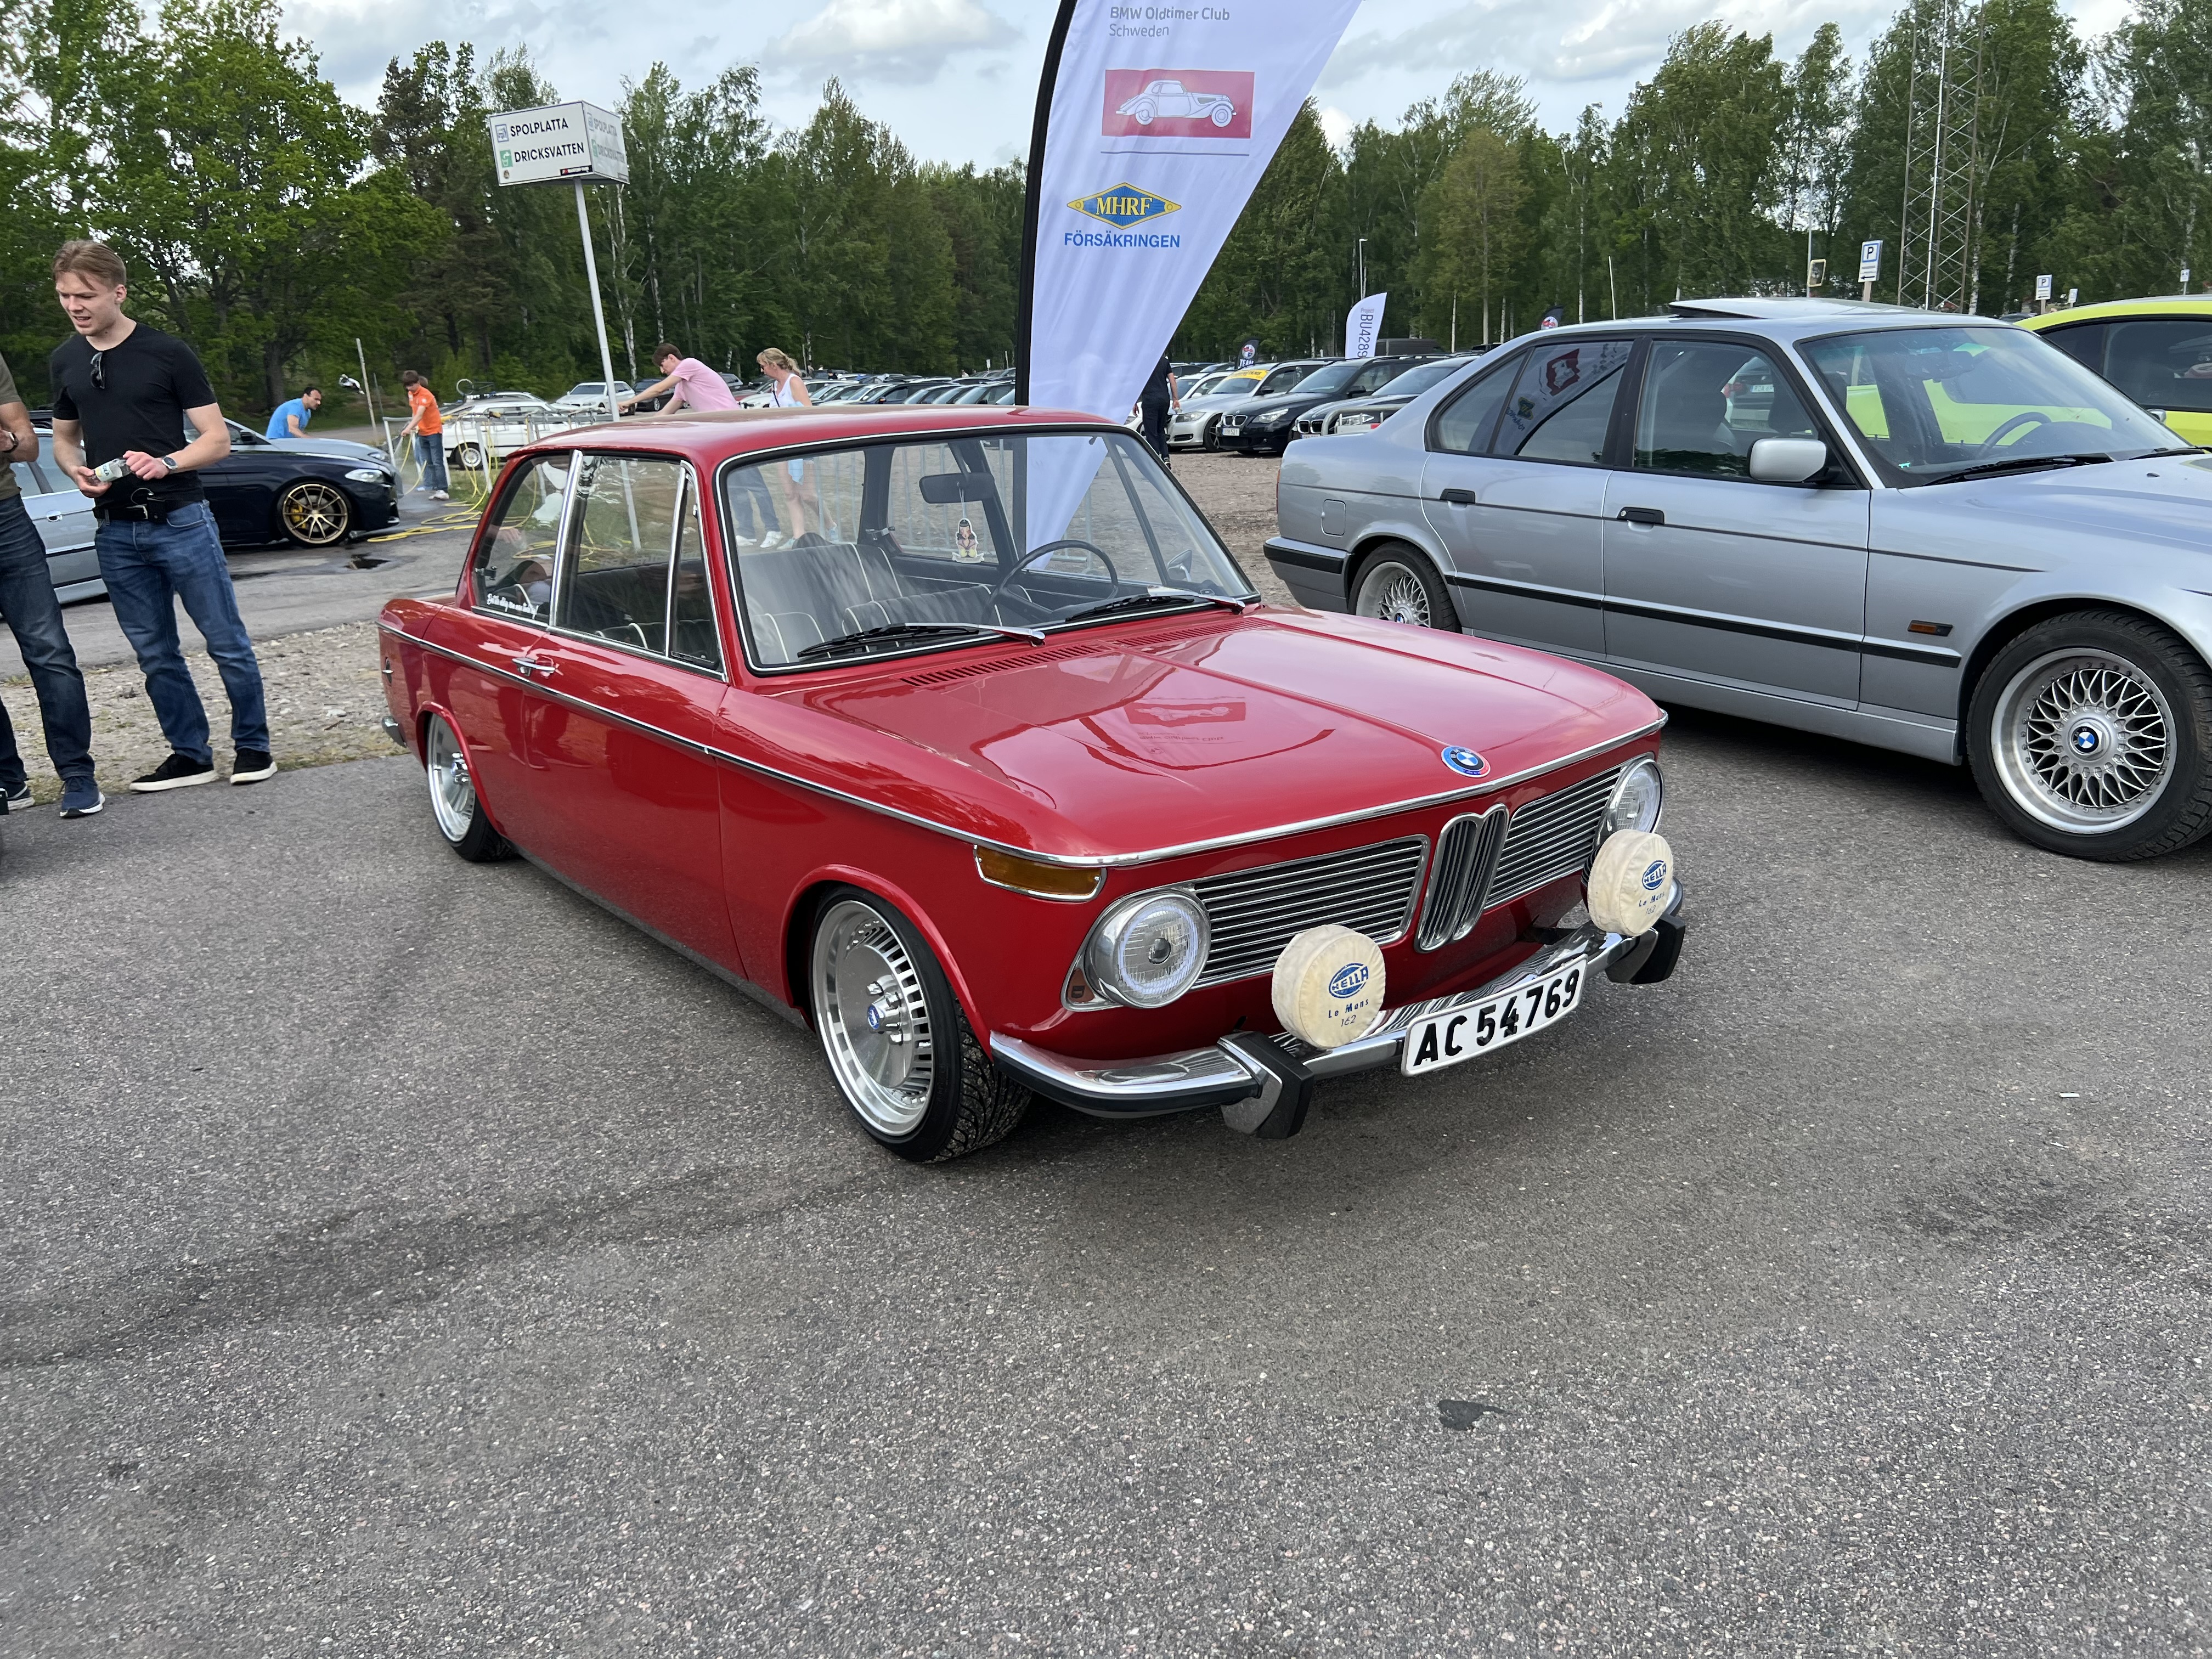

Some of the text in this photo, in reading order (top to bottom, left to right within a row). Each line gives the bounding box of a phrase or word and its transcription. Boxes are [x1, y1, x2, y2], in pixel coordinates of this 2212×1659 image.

[1110, 7, 1230, 20] BMW Oldtimer Club
[1109, 24, 1169, 37] Schweden
[510, 117, 568, 137] SPOLPLATTA
[514, 142, 584, 162] DRICKSVATTEN
[1096, 196, 1153, 216] MHRF
[1064, 230, 1180, 247] FÖRSÄKRINGEN
[1866, 246, 1874, 259] P
[1450, 749, 1472, 759] BMW
[1644, 862, 1666, 883] HELLA
[1331, 966, 1369, 991] HELLA
[1328, 998, 1369, 1018] Le Mans
[1413, 968, 1580, 1066] AC 54769
